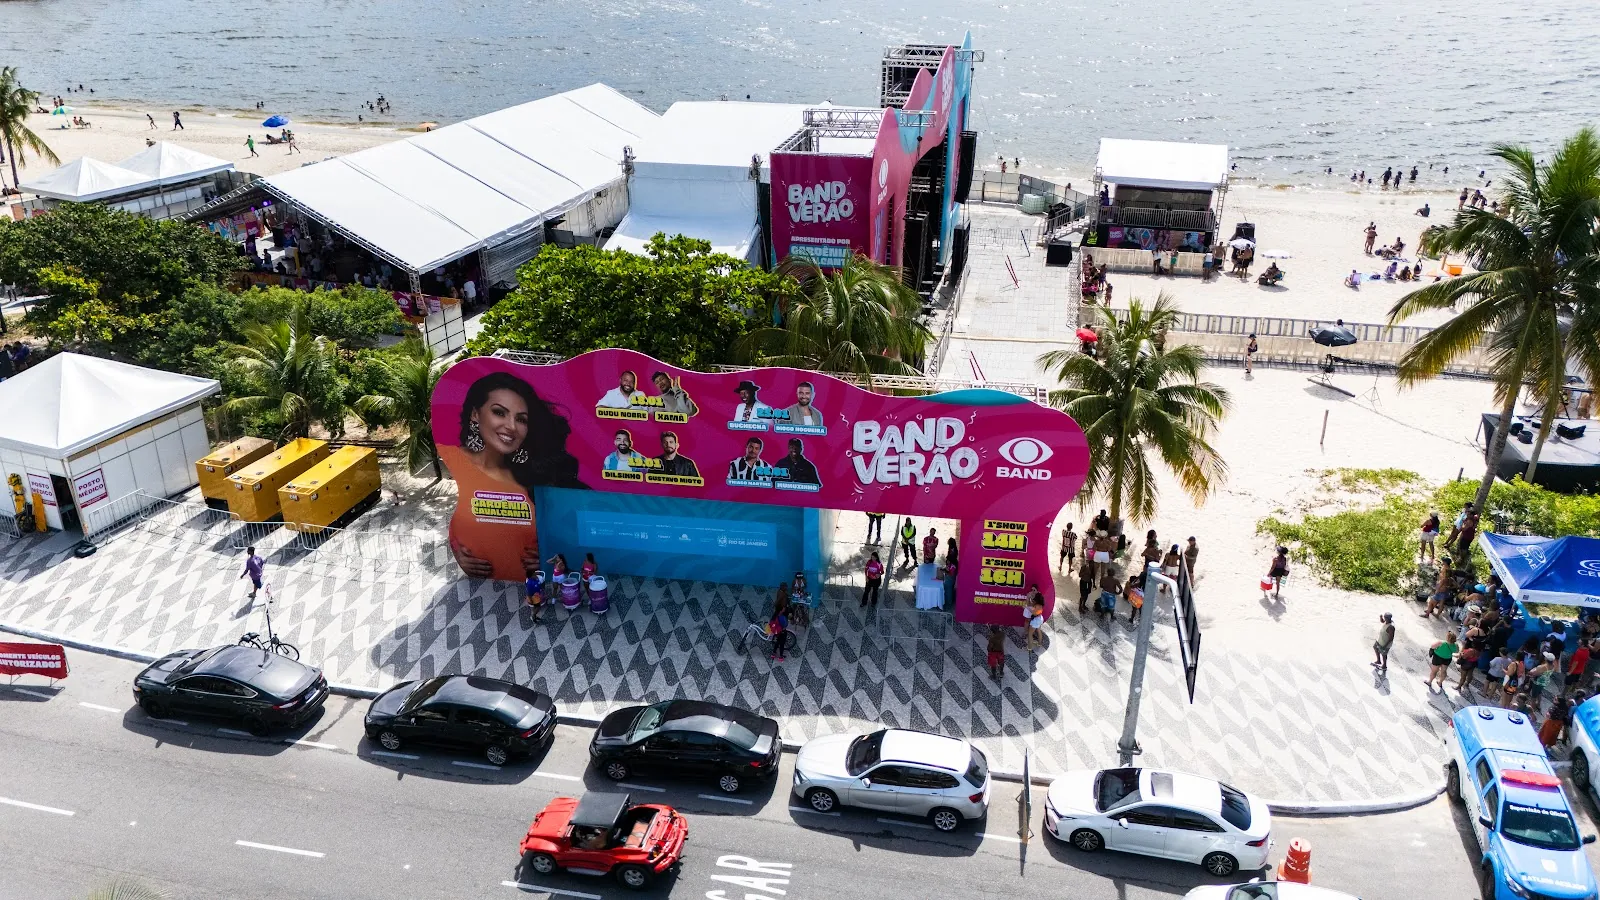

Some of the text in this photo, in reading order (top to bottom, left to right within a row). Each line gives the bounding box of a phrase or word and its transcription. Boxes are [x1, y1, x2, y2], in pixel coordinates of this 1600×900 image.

[788, 181, 846, 203] BAND
[788, 198, 854, 223] VERÃO
[791, 236, 836, 244] APRESENTADO
[630, 396, 664, 407] 18.01
[852, 417, 966, 453] BAND
[628, 457, 662, 468] 19.01
[852, 446, 979, 486] VERÃO
[605, 471, 641, 480] DILSINHO
[996, 466, 1052, 481] BAND
[31, 481, 50, 489] POSTO
[78, 478, 101, 490] POSTO
[79, 484, 104, 498] MÉDICO
[472, 499, 529, 511] GARDÊNIA
[473, 507, 529, 518] CAVALCANTI
[982, 532, 1026, 550] 14H
[980, 568, 1024, 586] 16H
